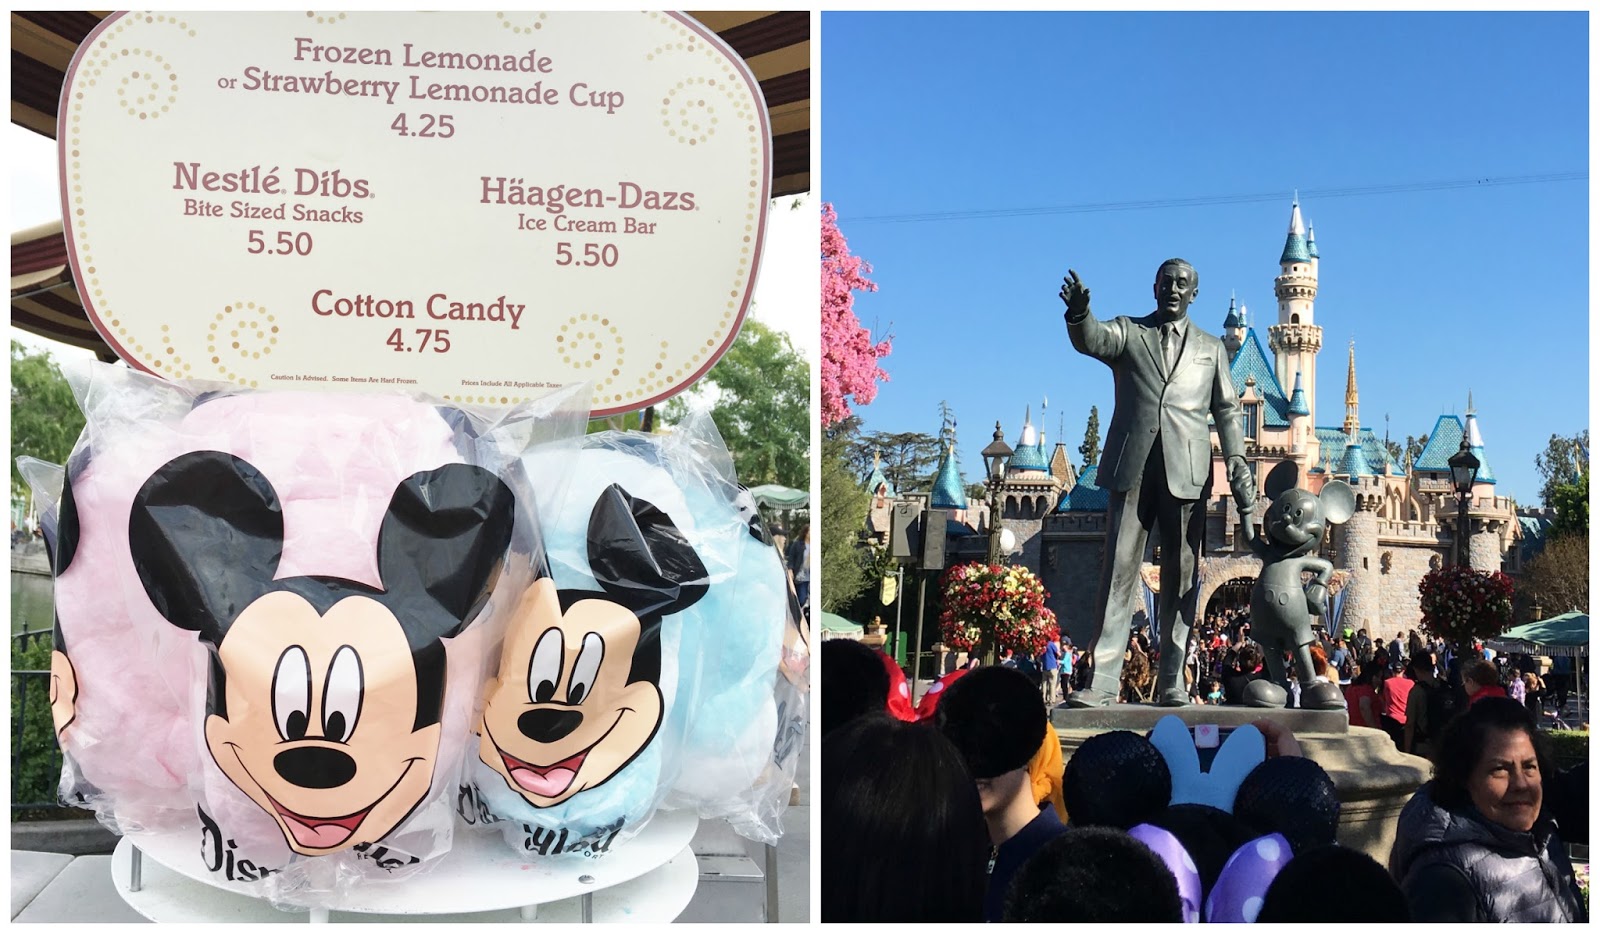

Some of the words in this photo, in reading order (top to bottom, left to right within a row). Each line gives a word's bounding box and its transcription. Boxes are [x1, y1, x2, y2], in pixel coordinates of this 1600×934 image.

[294, 37, 393, 66] Frozen
[402, 43, 553, 75] Lemonade
[217, 77, 238, 89] or
[242, 66, 400, 105] Strawberry
[408, 75, 559, 107] Lemonade
[569, 83, 625, 115] Cup
[390, 113, 456, 139] 4.25
[172, 161, 281, 195] Nestlé
[293, 167, 370, 199] Dibs
[480, 176, 696, 214] Häagen-Dazs
[183, 198, 224, 217] Bite
[230, 200, 286, 220] Sized
[292, 203, 363, 223] Snacks
[518, 213, 547, 231] Ice
[553, 214, 617, 233] Cream
[623, 217, 657, 234] Bar
[247, 229, 313, 256] 5.50
[555, 242, 619, 267] 5.50
[311, 289, 416, 319] Cotton
[425, 293, 526, 330] Candy
[385, 327, 452, 354] 4.75
[270, 373, 294, 381] Caution
[302, 374, 329, 382] Advised.
[332, 375, 349, 383] Some
[396, 377, 419, 385] Frozen.
[513, 381, 545, 389] Applicable
